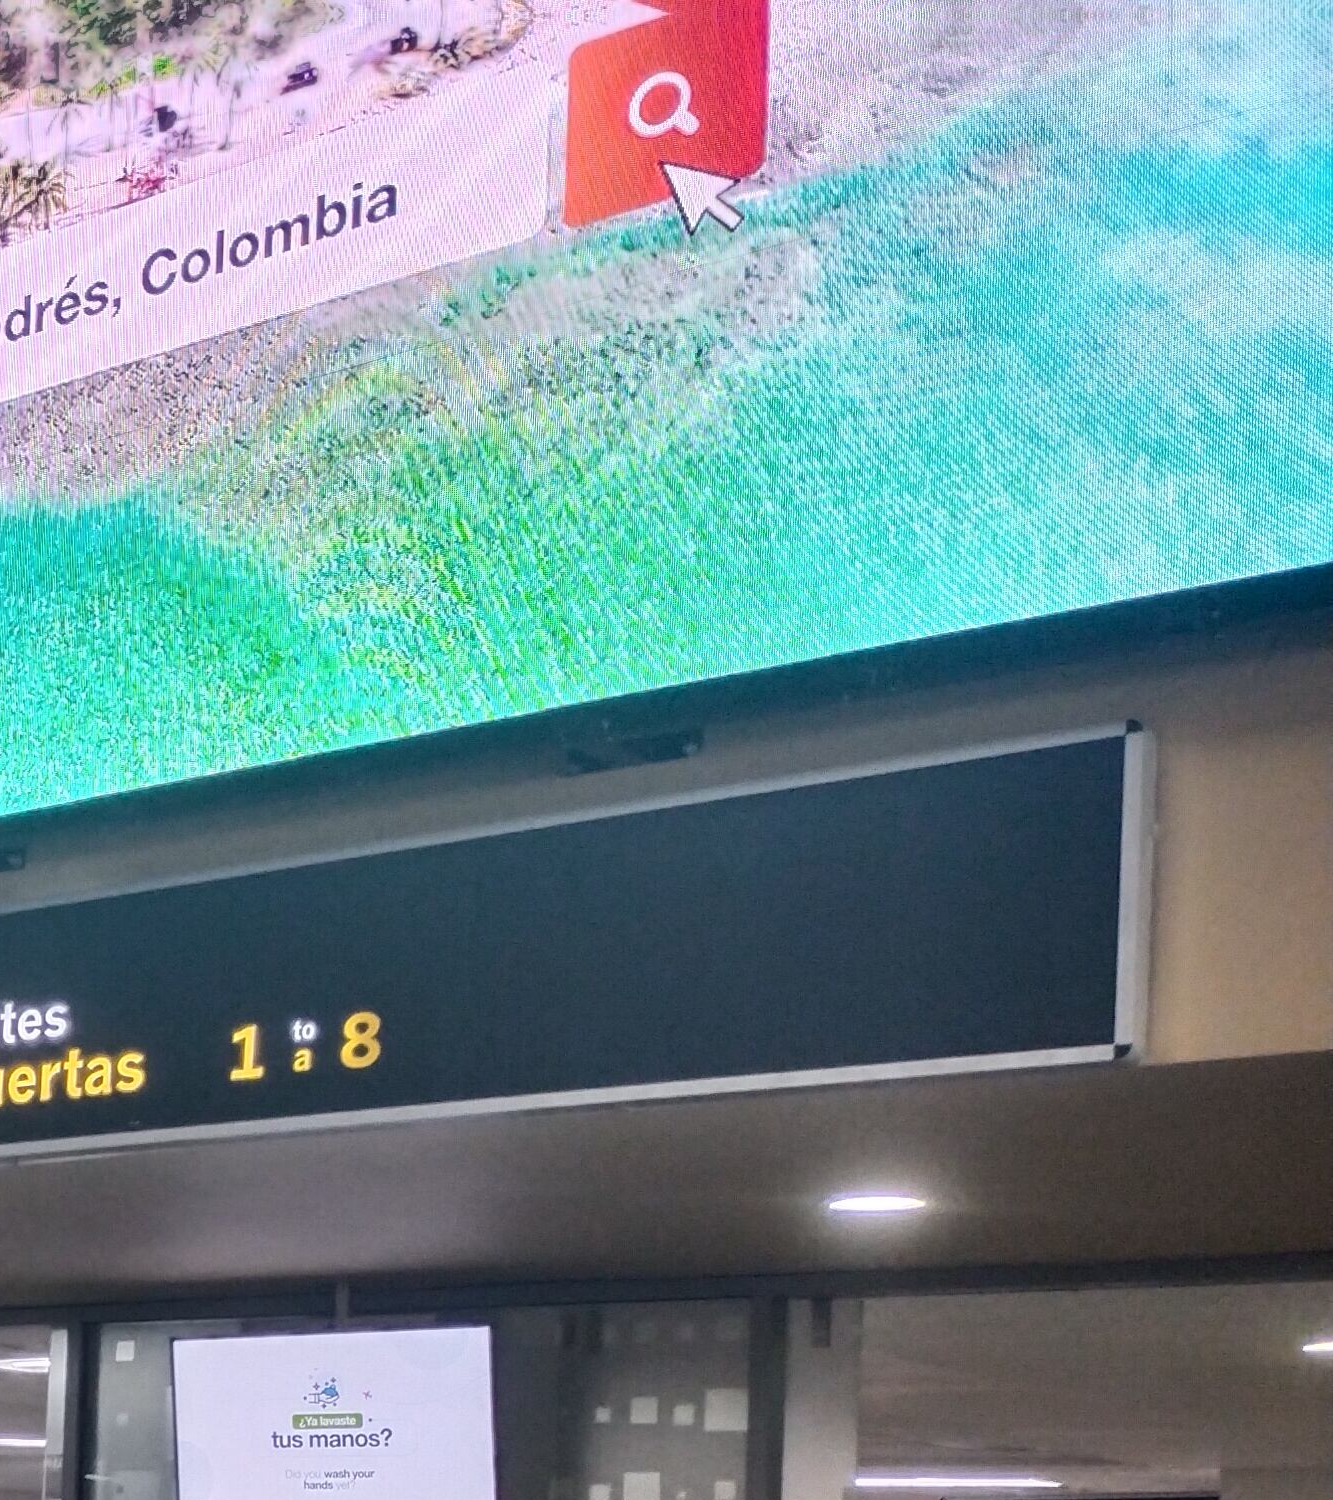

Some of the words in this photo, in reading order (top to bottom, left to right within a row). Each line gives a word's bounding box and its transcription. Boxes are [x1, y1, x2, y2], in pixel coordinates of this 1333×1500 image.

[142, 182, 398, 296] Colombia
[229, 1023, 264, 1082] 1
[291, 1018, 316, 1043] to
[340, 1011, 382, 1069] 8
[293, 1048, 313, 1073] a
[320, 1416, 356, 1426] lavaste
[271, 1431, 303, 1448] tus
[309, 1428, 393, 1448] manos?
[285, 1469, 301, 1479] Did
[302, 1471, 321, 1481] you
[324, 1469, 350, 1479] wash
[352, 1470, 375, 1480] your
[304, 1480, 333, 1490] hands
